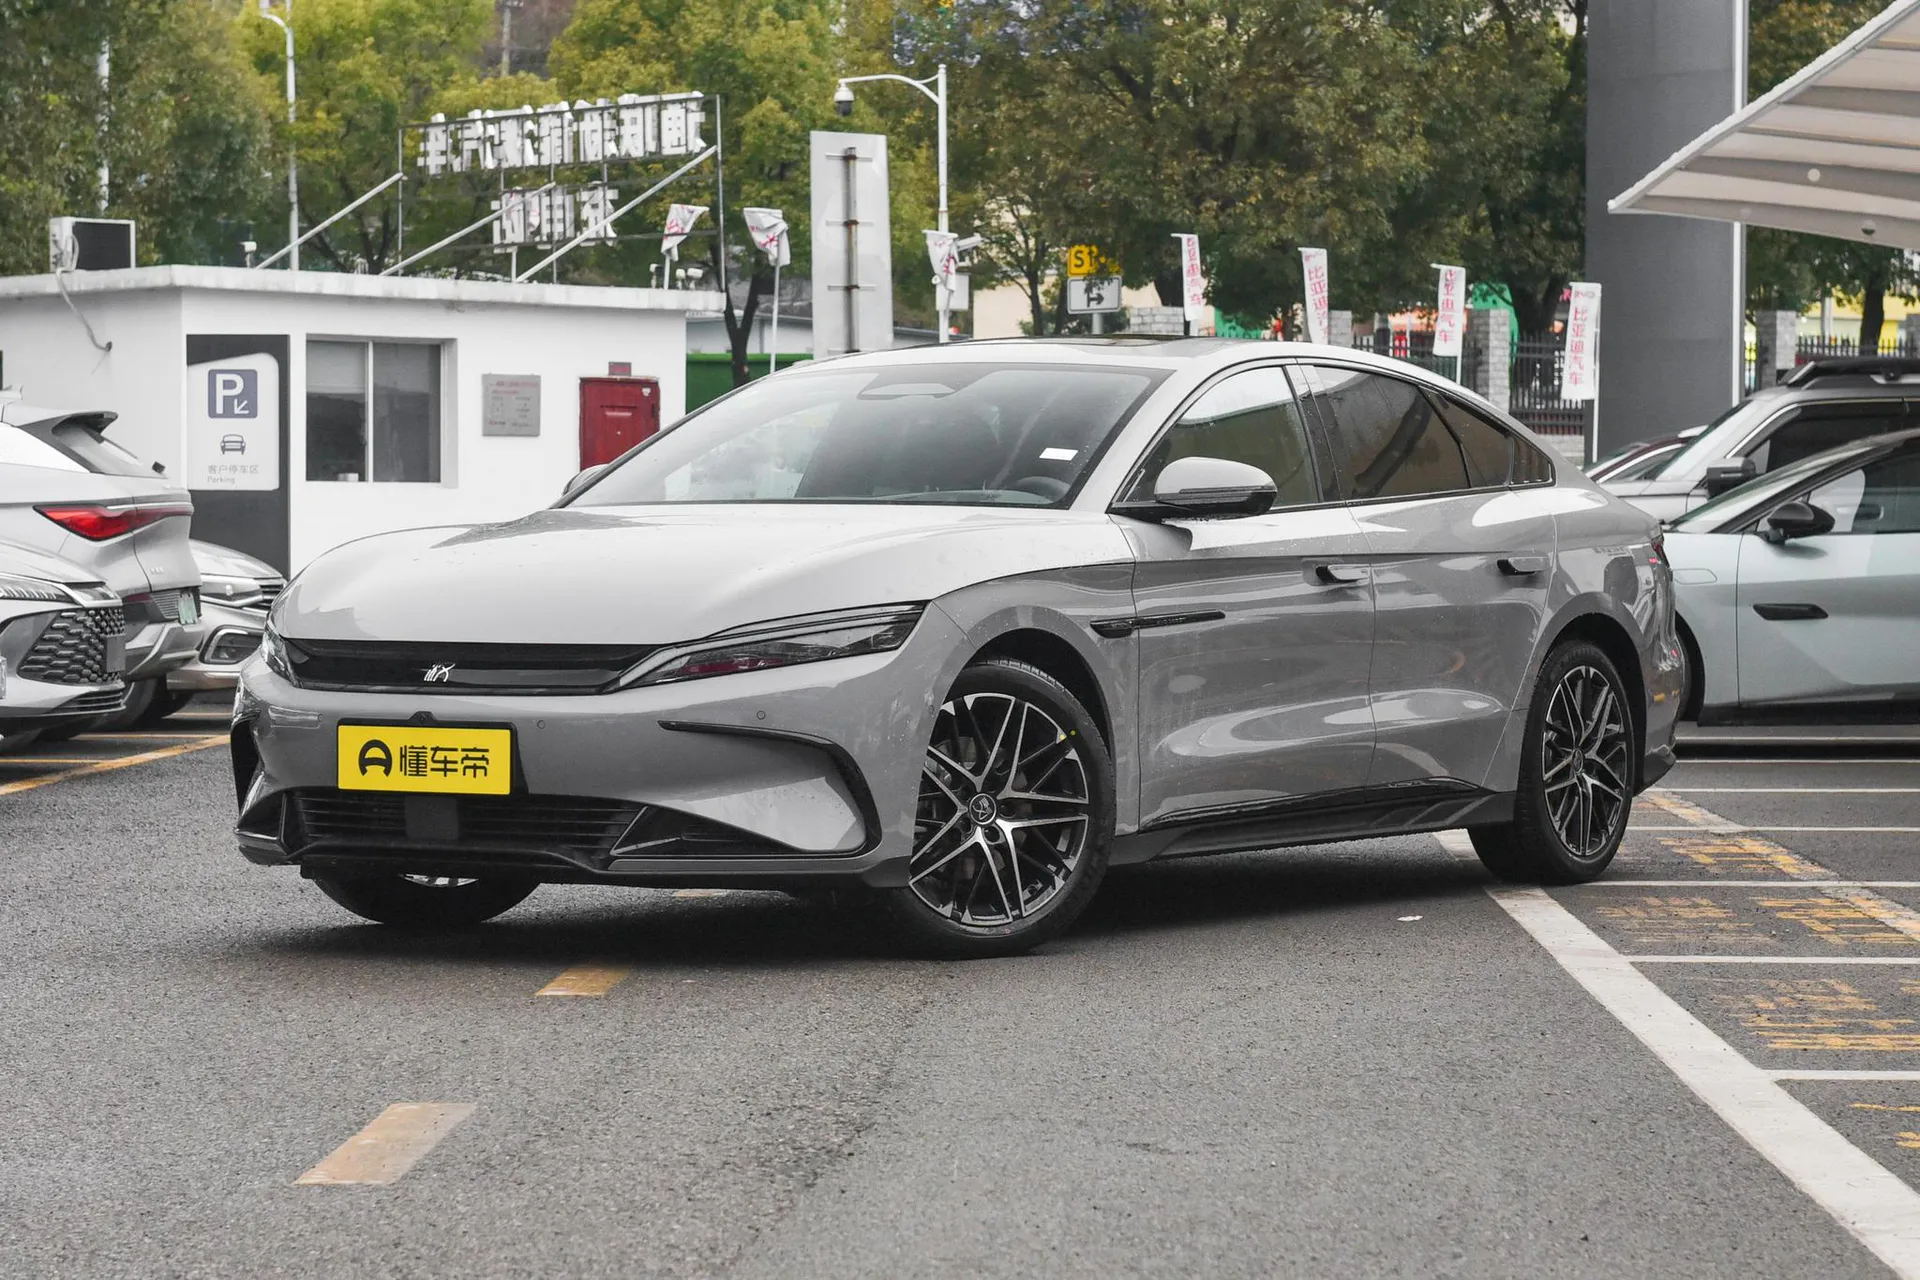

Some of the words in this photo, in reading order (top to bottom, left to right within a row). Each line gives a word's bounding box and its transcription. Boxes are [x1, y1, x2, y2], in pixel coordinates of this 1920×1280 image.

[215, 373, 244, 415] P
[207, 475, 236, 485] Parking
[208, 464, 259, 475] 客户停车区
[399, 744, 490, 778] 懂车帝
